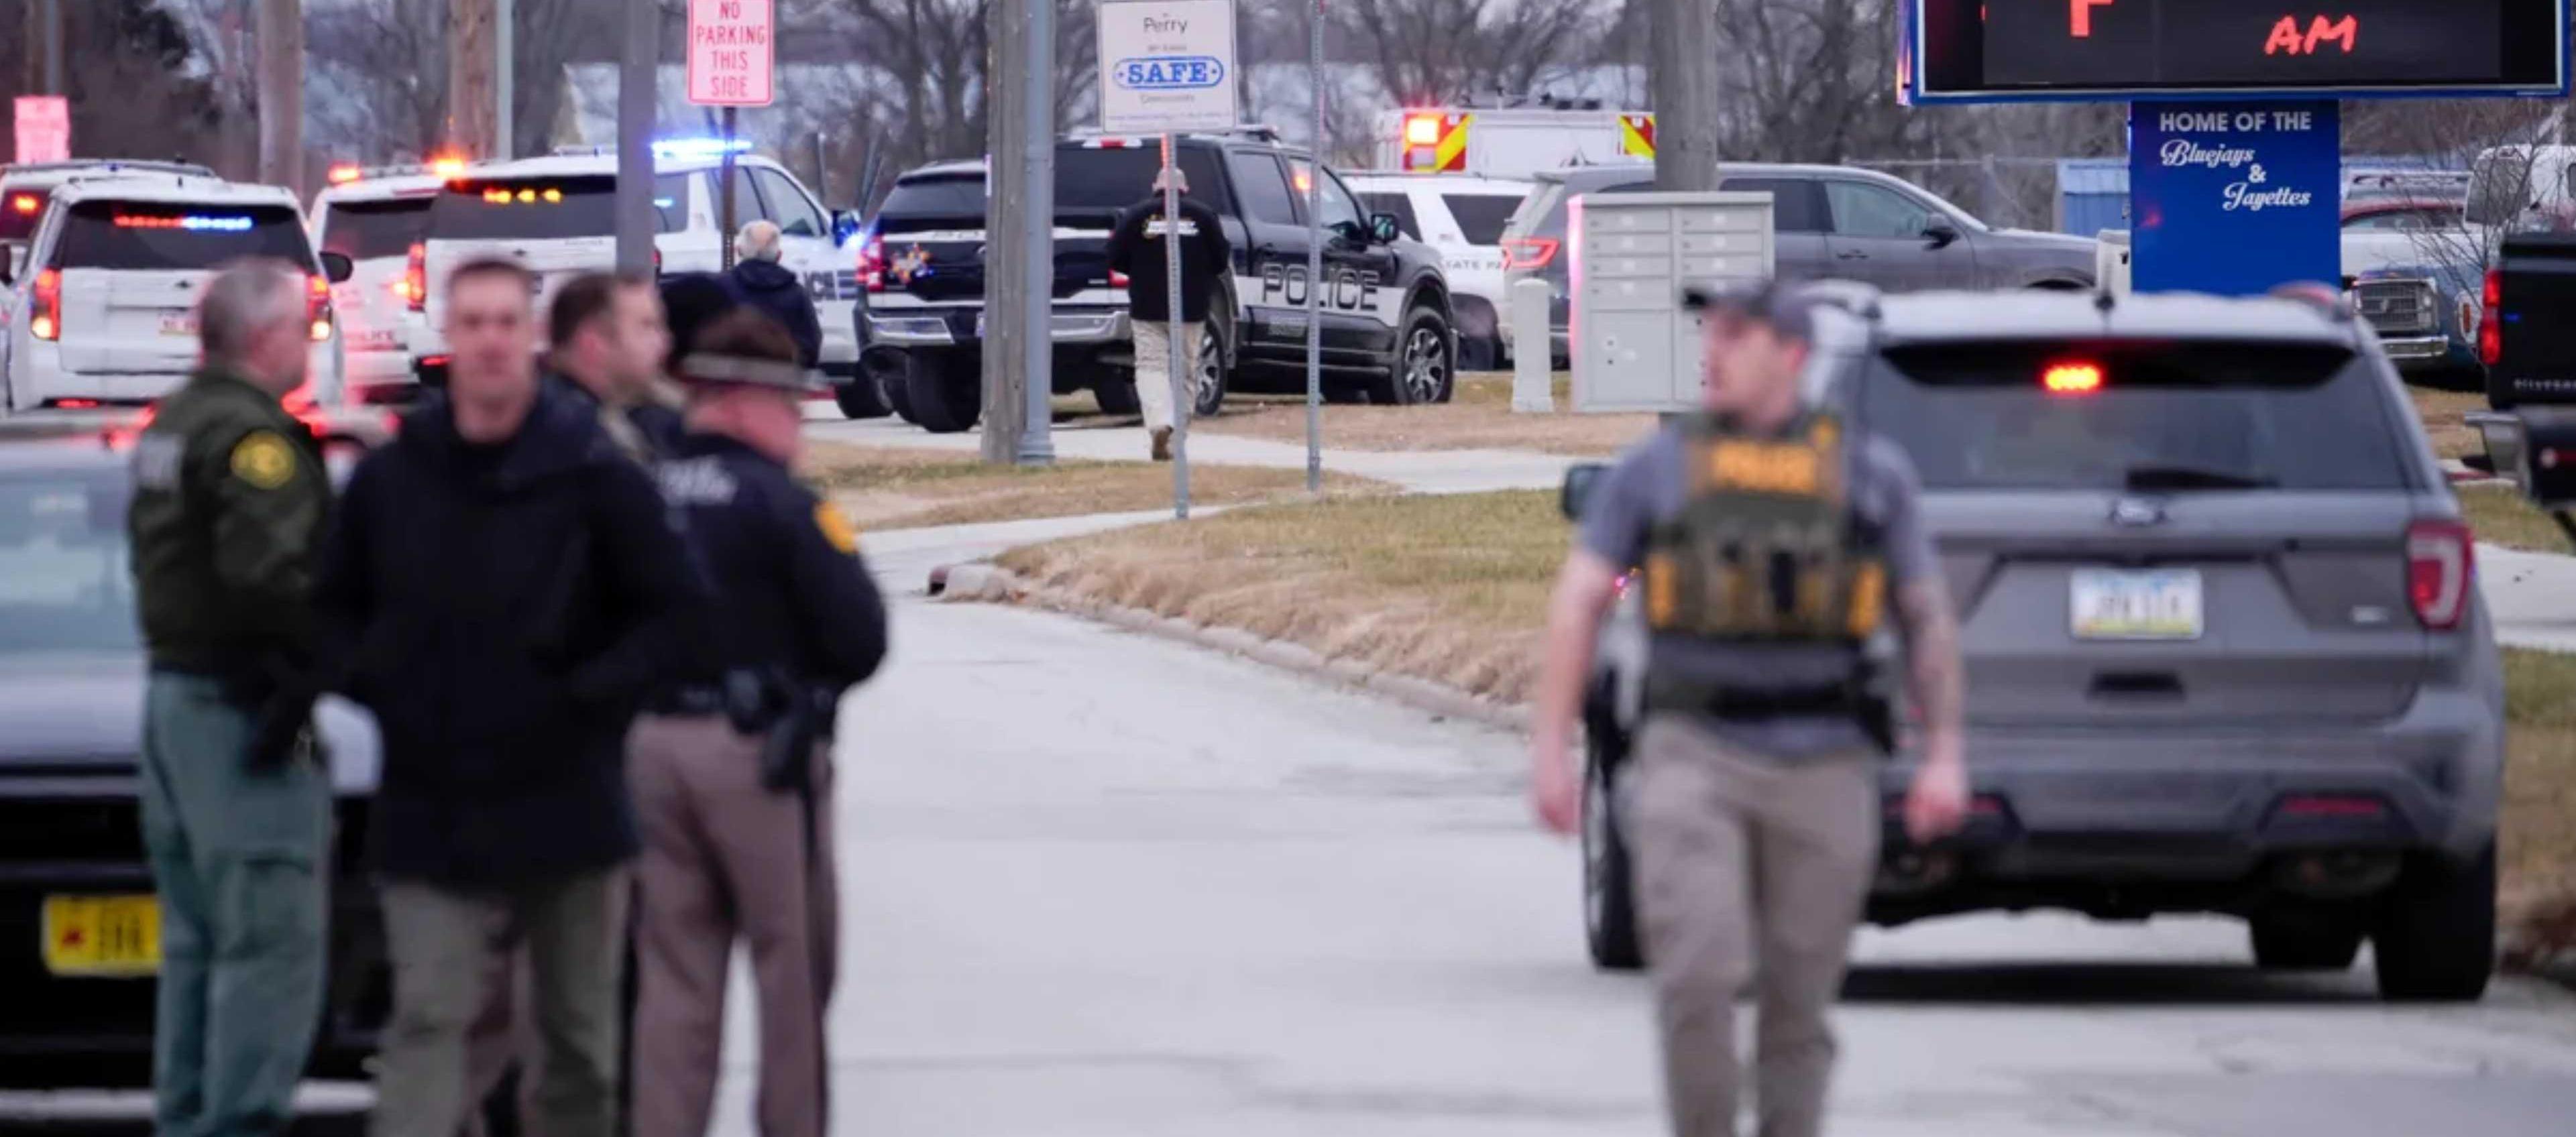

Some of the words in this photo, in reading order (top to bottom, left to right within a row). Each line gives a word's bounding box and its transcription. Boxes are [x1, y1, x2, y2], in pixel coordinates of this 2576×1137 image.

[719, 1, 741, 19] NO
[696, 25, 765, 45] PARKING
[1143, 17, 1188, 34] Perry
[2264, 15, 2357, 55] AM
[711, 50, 748, 70] THIS
[1127, 62, 1207, 84] SAFE
[711, 76, 747, 97] SIDE
[2160, 113, 2229, 132] HOME
[2235, 112, 2267, 131] OF
[2272, 111, 2312, 131] THE
[2160, 139, 2256, 168] Bluejays
[2248, 163, 2267, 183] &
[2222, 182, 2312, 211] Jayettes
[1262, 263, 1380, 310] POICE
